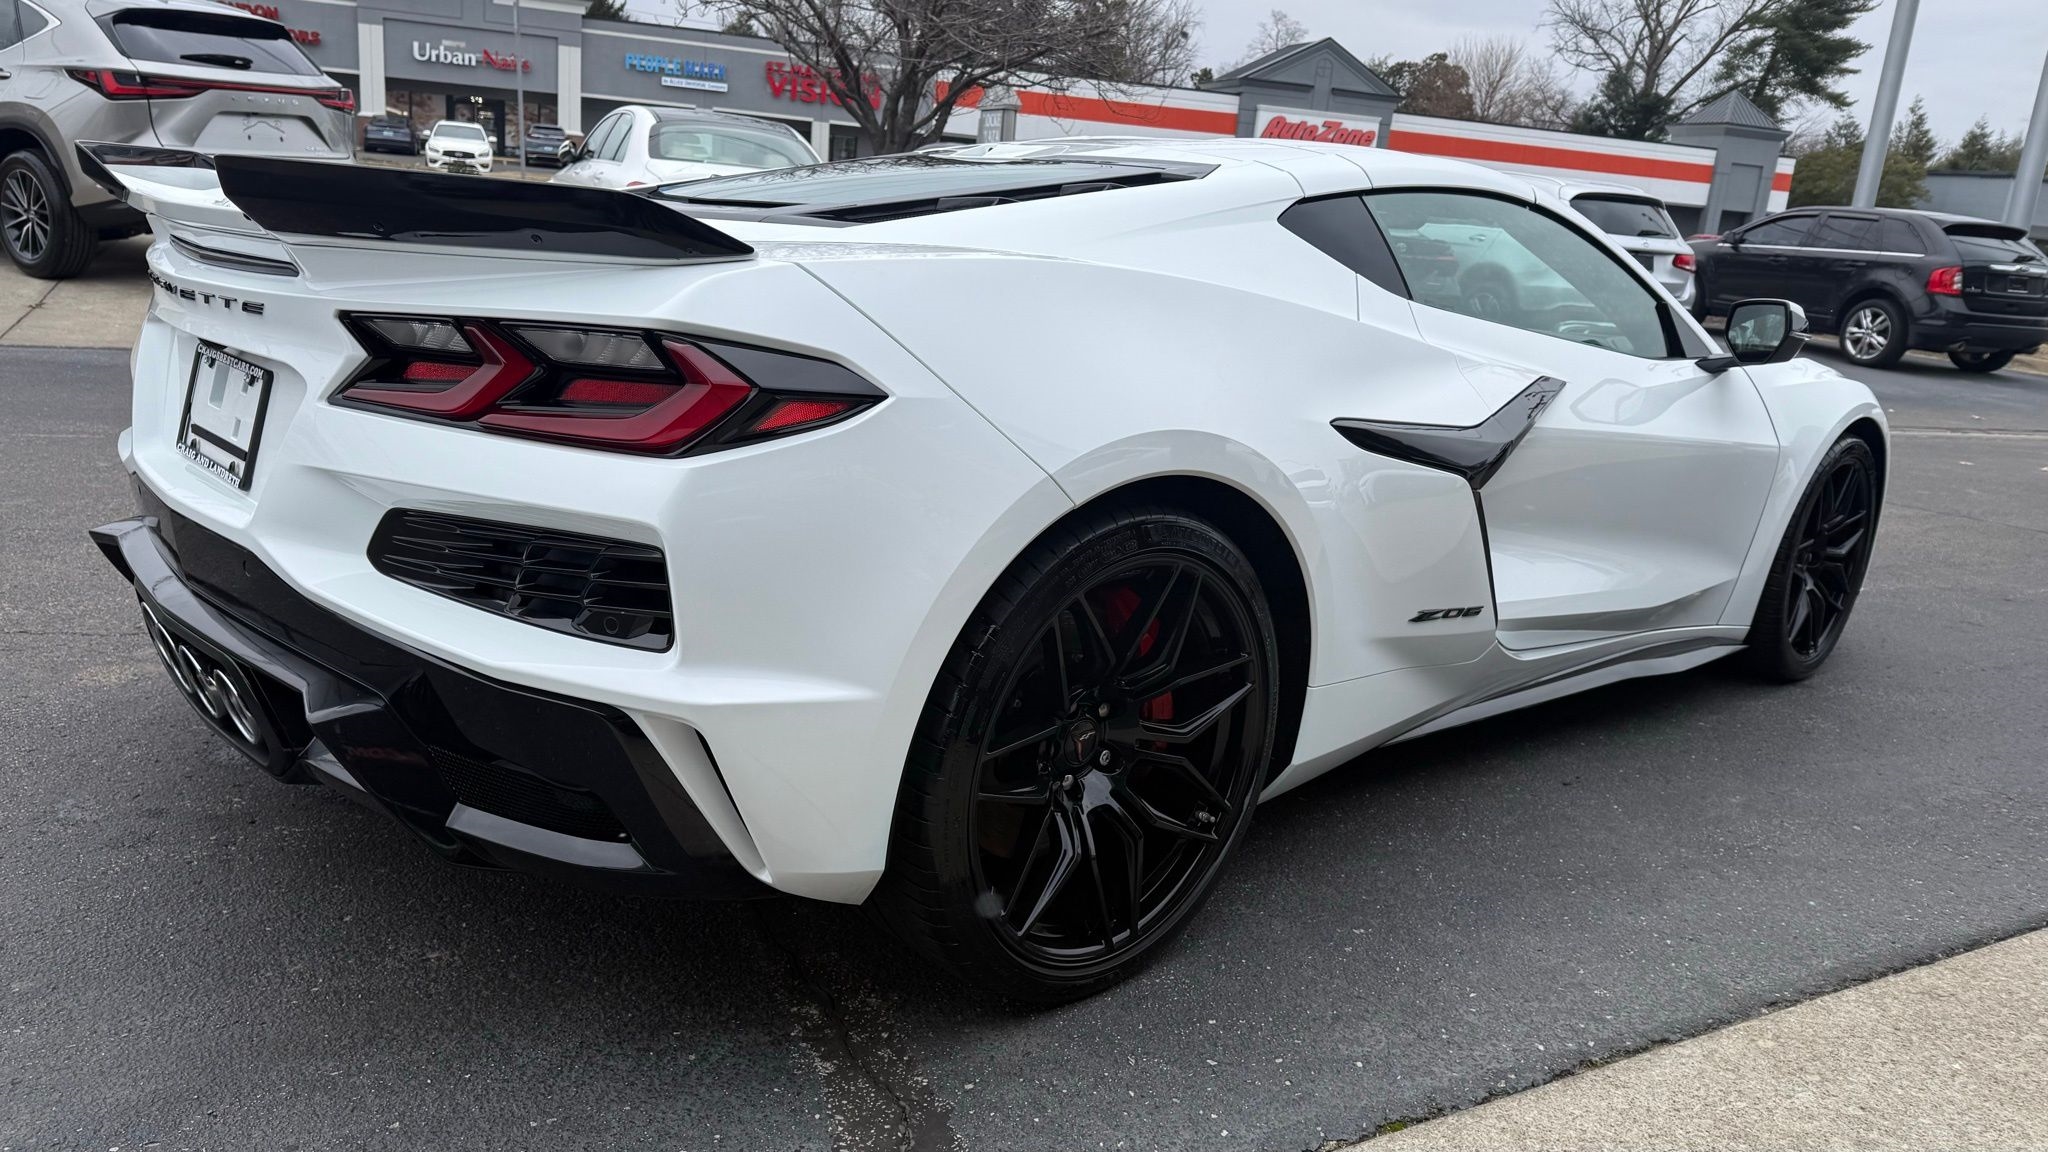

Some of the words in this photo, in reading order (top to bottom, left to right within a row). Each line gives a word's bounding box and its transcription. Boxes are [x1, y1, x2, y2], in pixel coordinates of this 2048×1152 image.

[412, 40, 477, 66] Urban
[482, 48, 531, 73] Nais
[625, 53, 681, 75] PEOPLE
[1260, 115, 1377, 147] AutoZone
[198, 344, 264, 379] CRAIGSBESTCARS.COM
[177, 443, 196, 459] CRAIG
[196, 454, 210, 467] AND
[209, 461, 241, 488] LANDRETH
[1408, 605, 1484, 622] Z06
